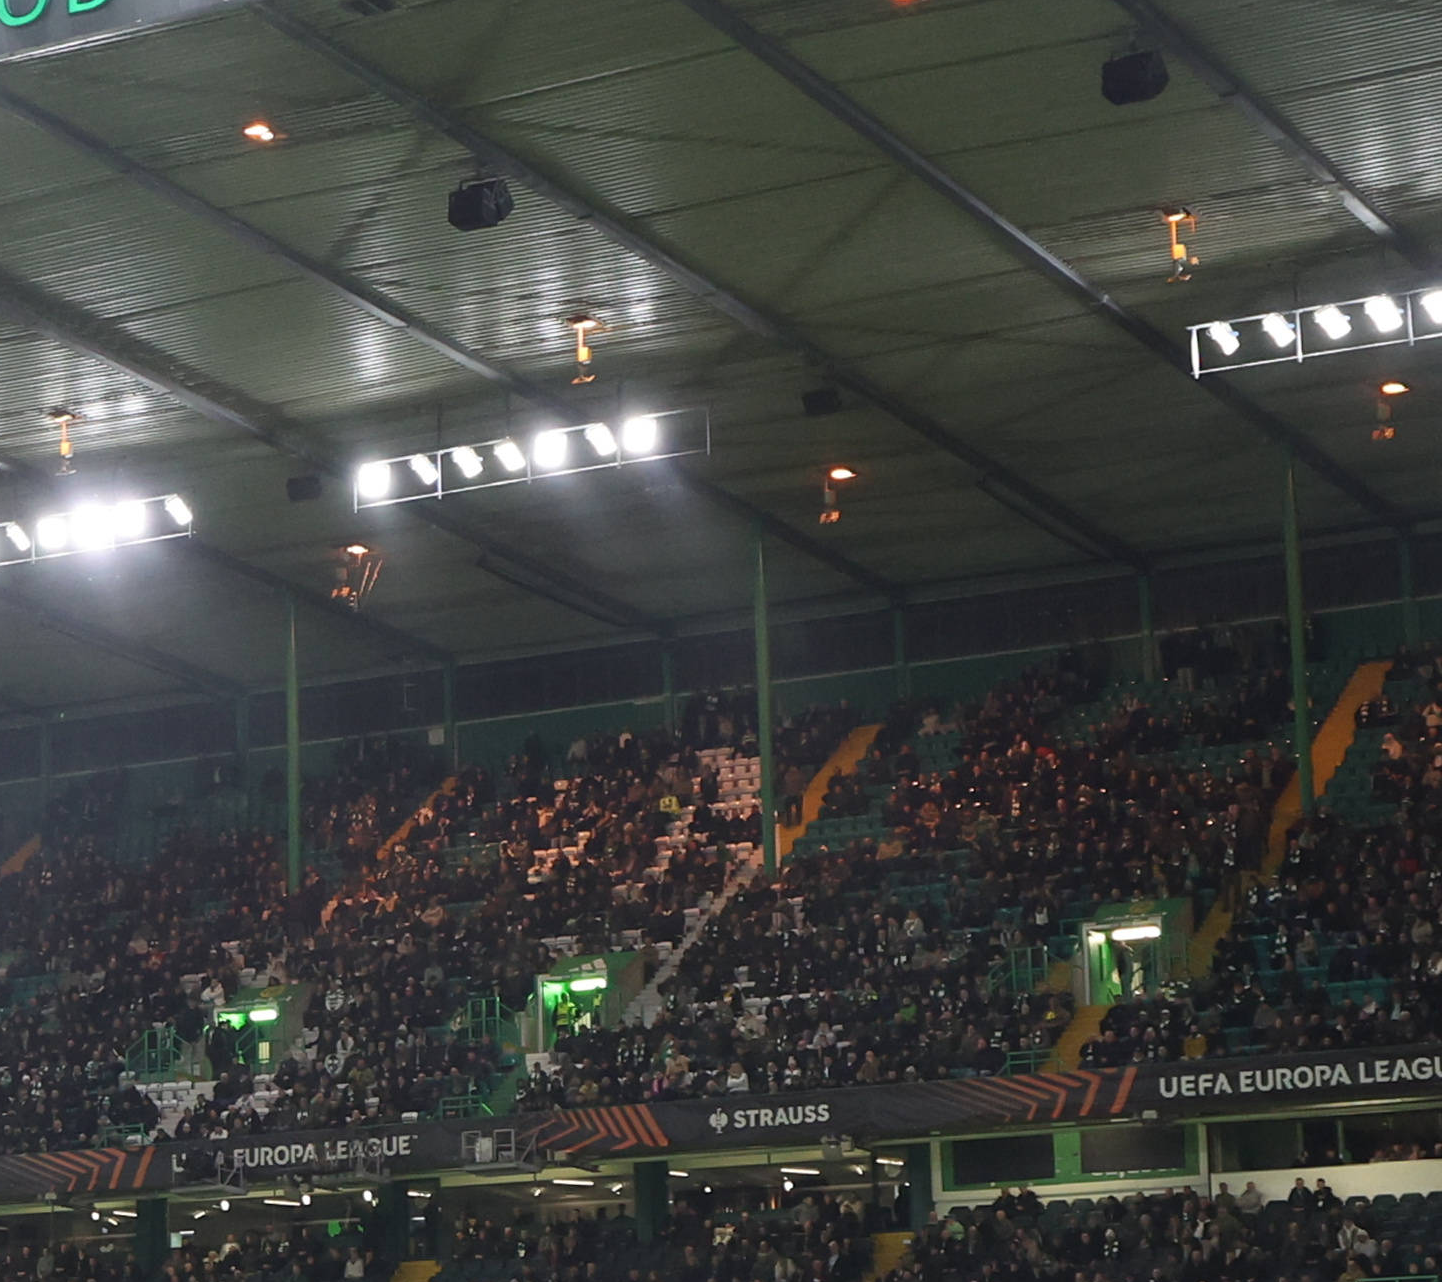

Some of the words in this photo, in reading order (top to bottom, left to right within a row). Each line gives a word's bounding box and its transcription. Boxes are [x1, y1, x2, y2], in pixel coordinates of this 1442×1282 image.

[1159, 1074, 1233, 1098] UEFA
[1239, 1063, 1351, 1093] EUROPA
[733, 1104, 830, 1128] STRAUSS
